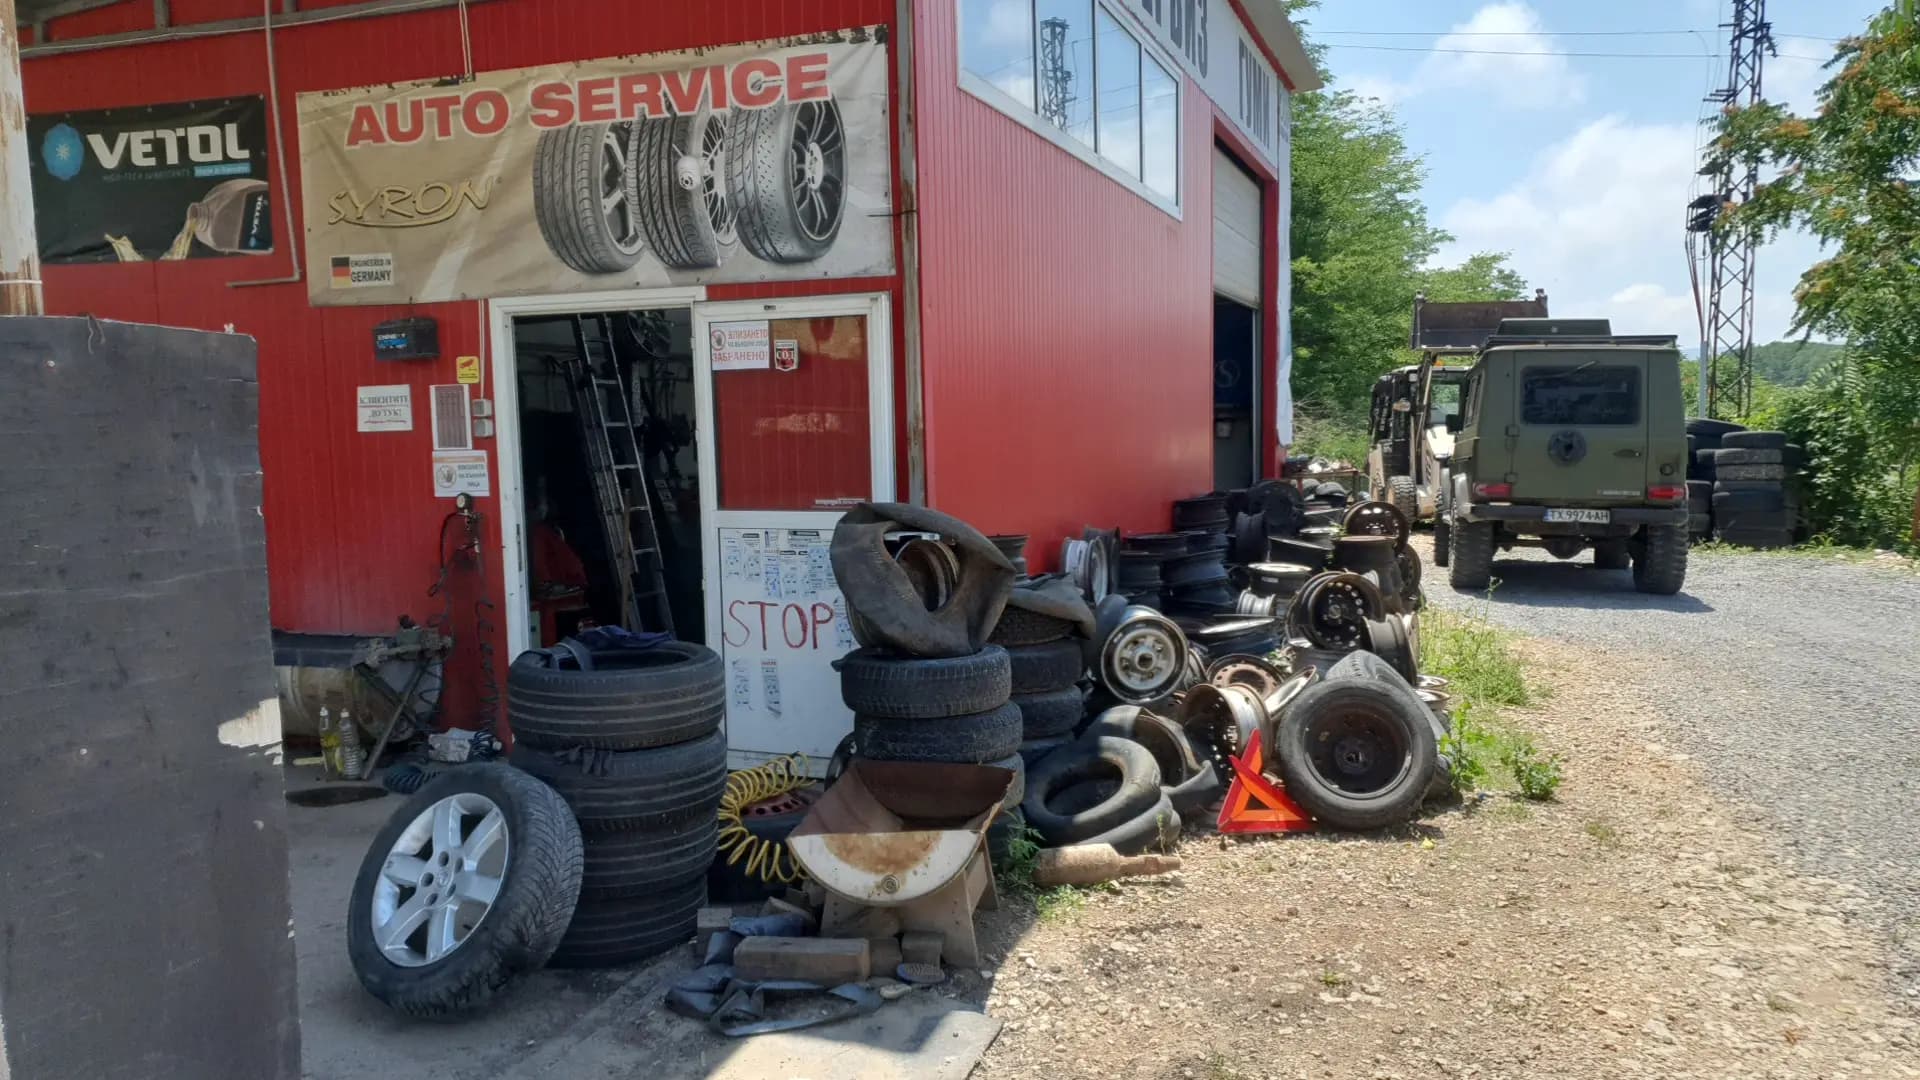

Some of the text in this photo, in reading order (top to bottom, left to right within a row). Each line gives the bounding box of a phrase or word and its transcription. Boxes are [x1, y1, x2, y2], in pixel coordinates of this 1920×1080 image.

[346, 52, 830, 147] AUTO SERVICE
[86, 122, 250, 170] VETOL
[327, 175, 494, 228] SYRON
[351, 270, 391, 282] GERMANY
[723, 600, 834, 651] STOP
